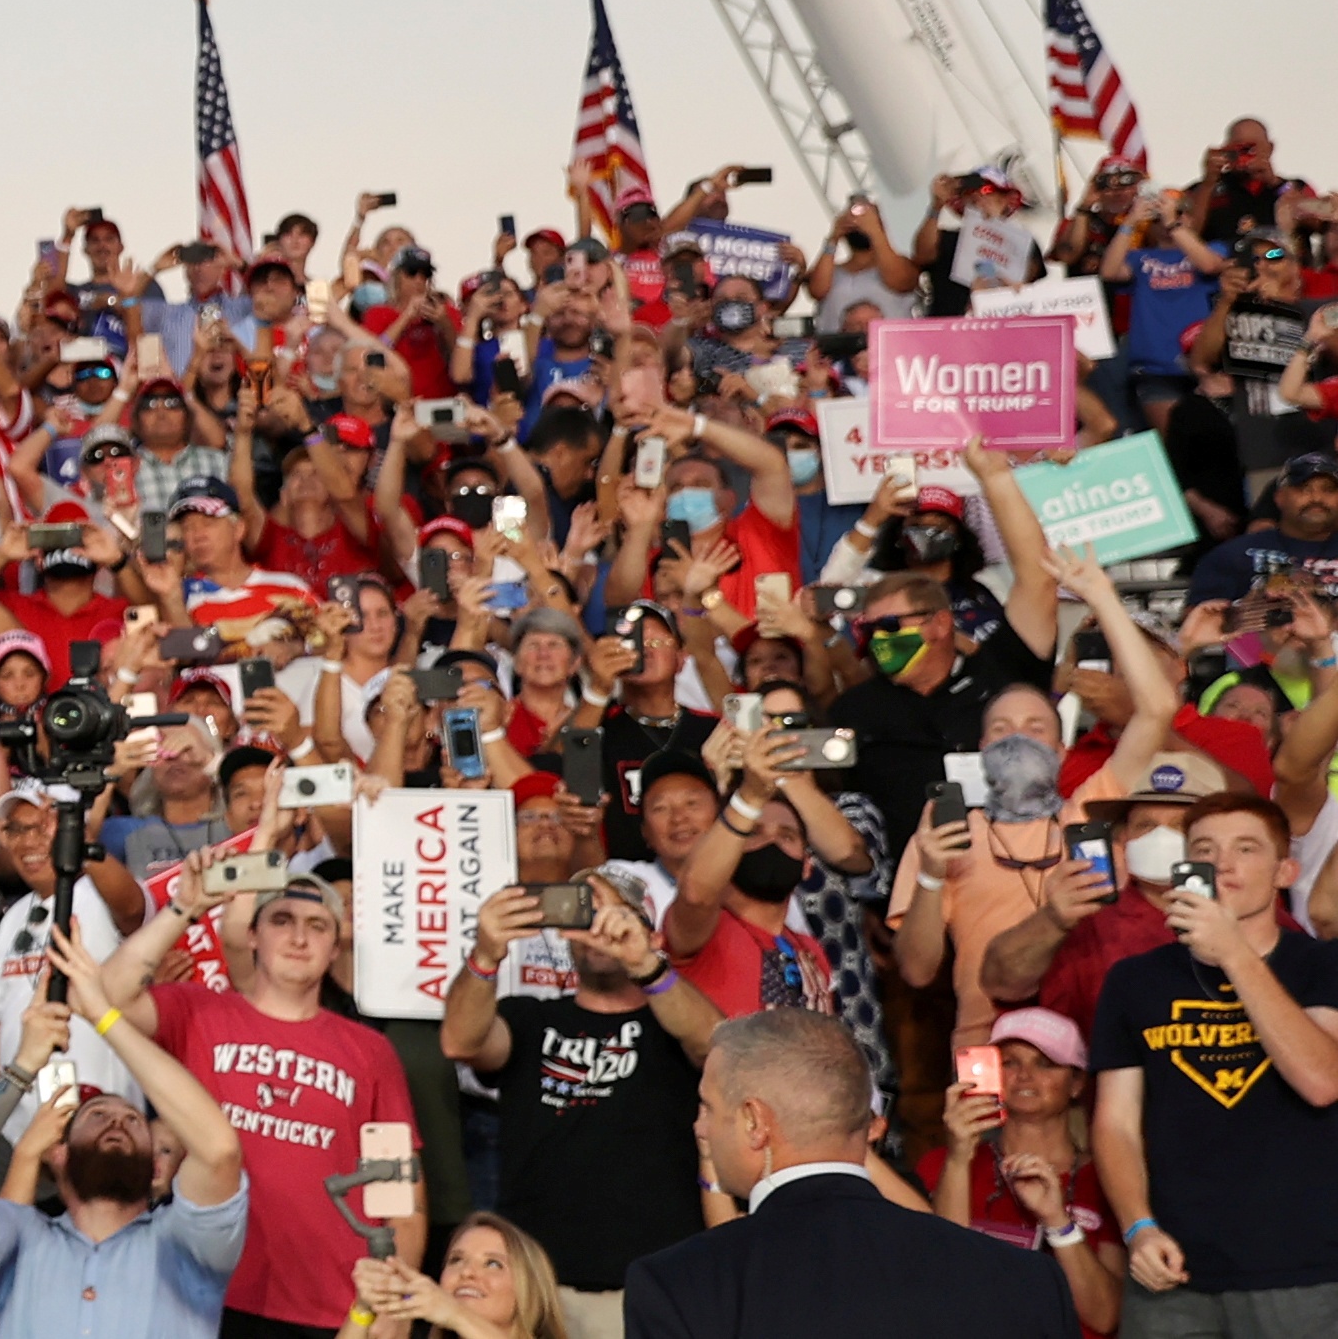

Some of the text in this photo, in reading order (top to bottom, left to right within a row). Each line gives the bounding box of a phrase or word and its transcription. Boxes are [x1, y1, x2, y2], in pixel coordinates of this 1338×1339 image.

[714, 235, 781, 262] MORE
[707, 254, 774, 283] EARS!
[895, 354, 1051, 396] Women
[912, 395, 1038, 414] FOR TRUMP
[845, 426, 864, 444] 4
[1039, 472, 1153, 522] atinos
[457, 804, 481, 898] AGAIN
[383, 861, 405, 945] MAKE
[415, 805, 448, 1002] AMERICA
[1142, 1021, 1262, 1051] WOLVER
[212, 1042, 357, 1109] WESTERN
[1214, 1066, 1247, 1091] M
